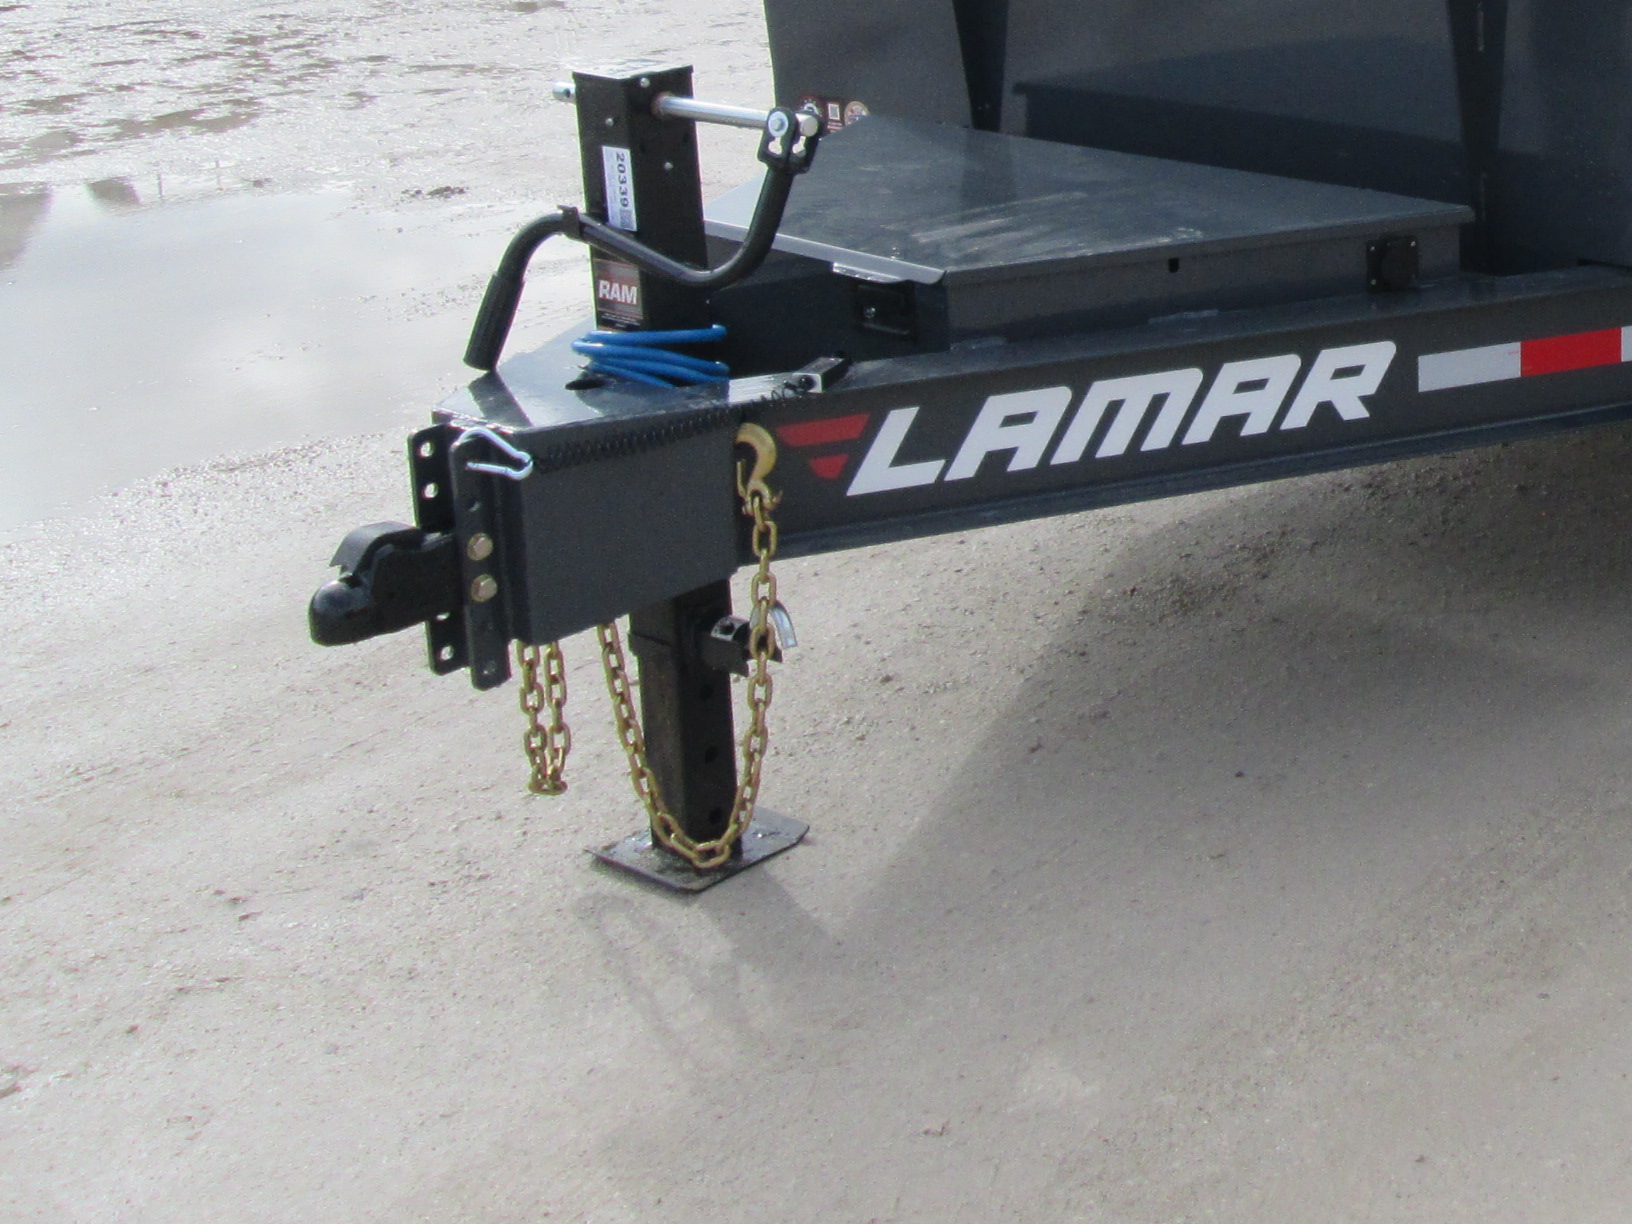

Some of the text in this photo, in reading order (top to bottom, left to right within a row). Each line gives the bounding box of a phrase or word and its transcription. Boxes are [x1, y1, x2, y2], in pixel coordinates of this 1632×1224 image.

[616, 152, 630, 208] 20339
[598, 279, 638, 305] RAM
[846, 341, 1397, 496] LAMAR
